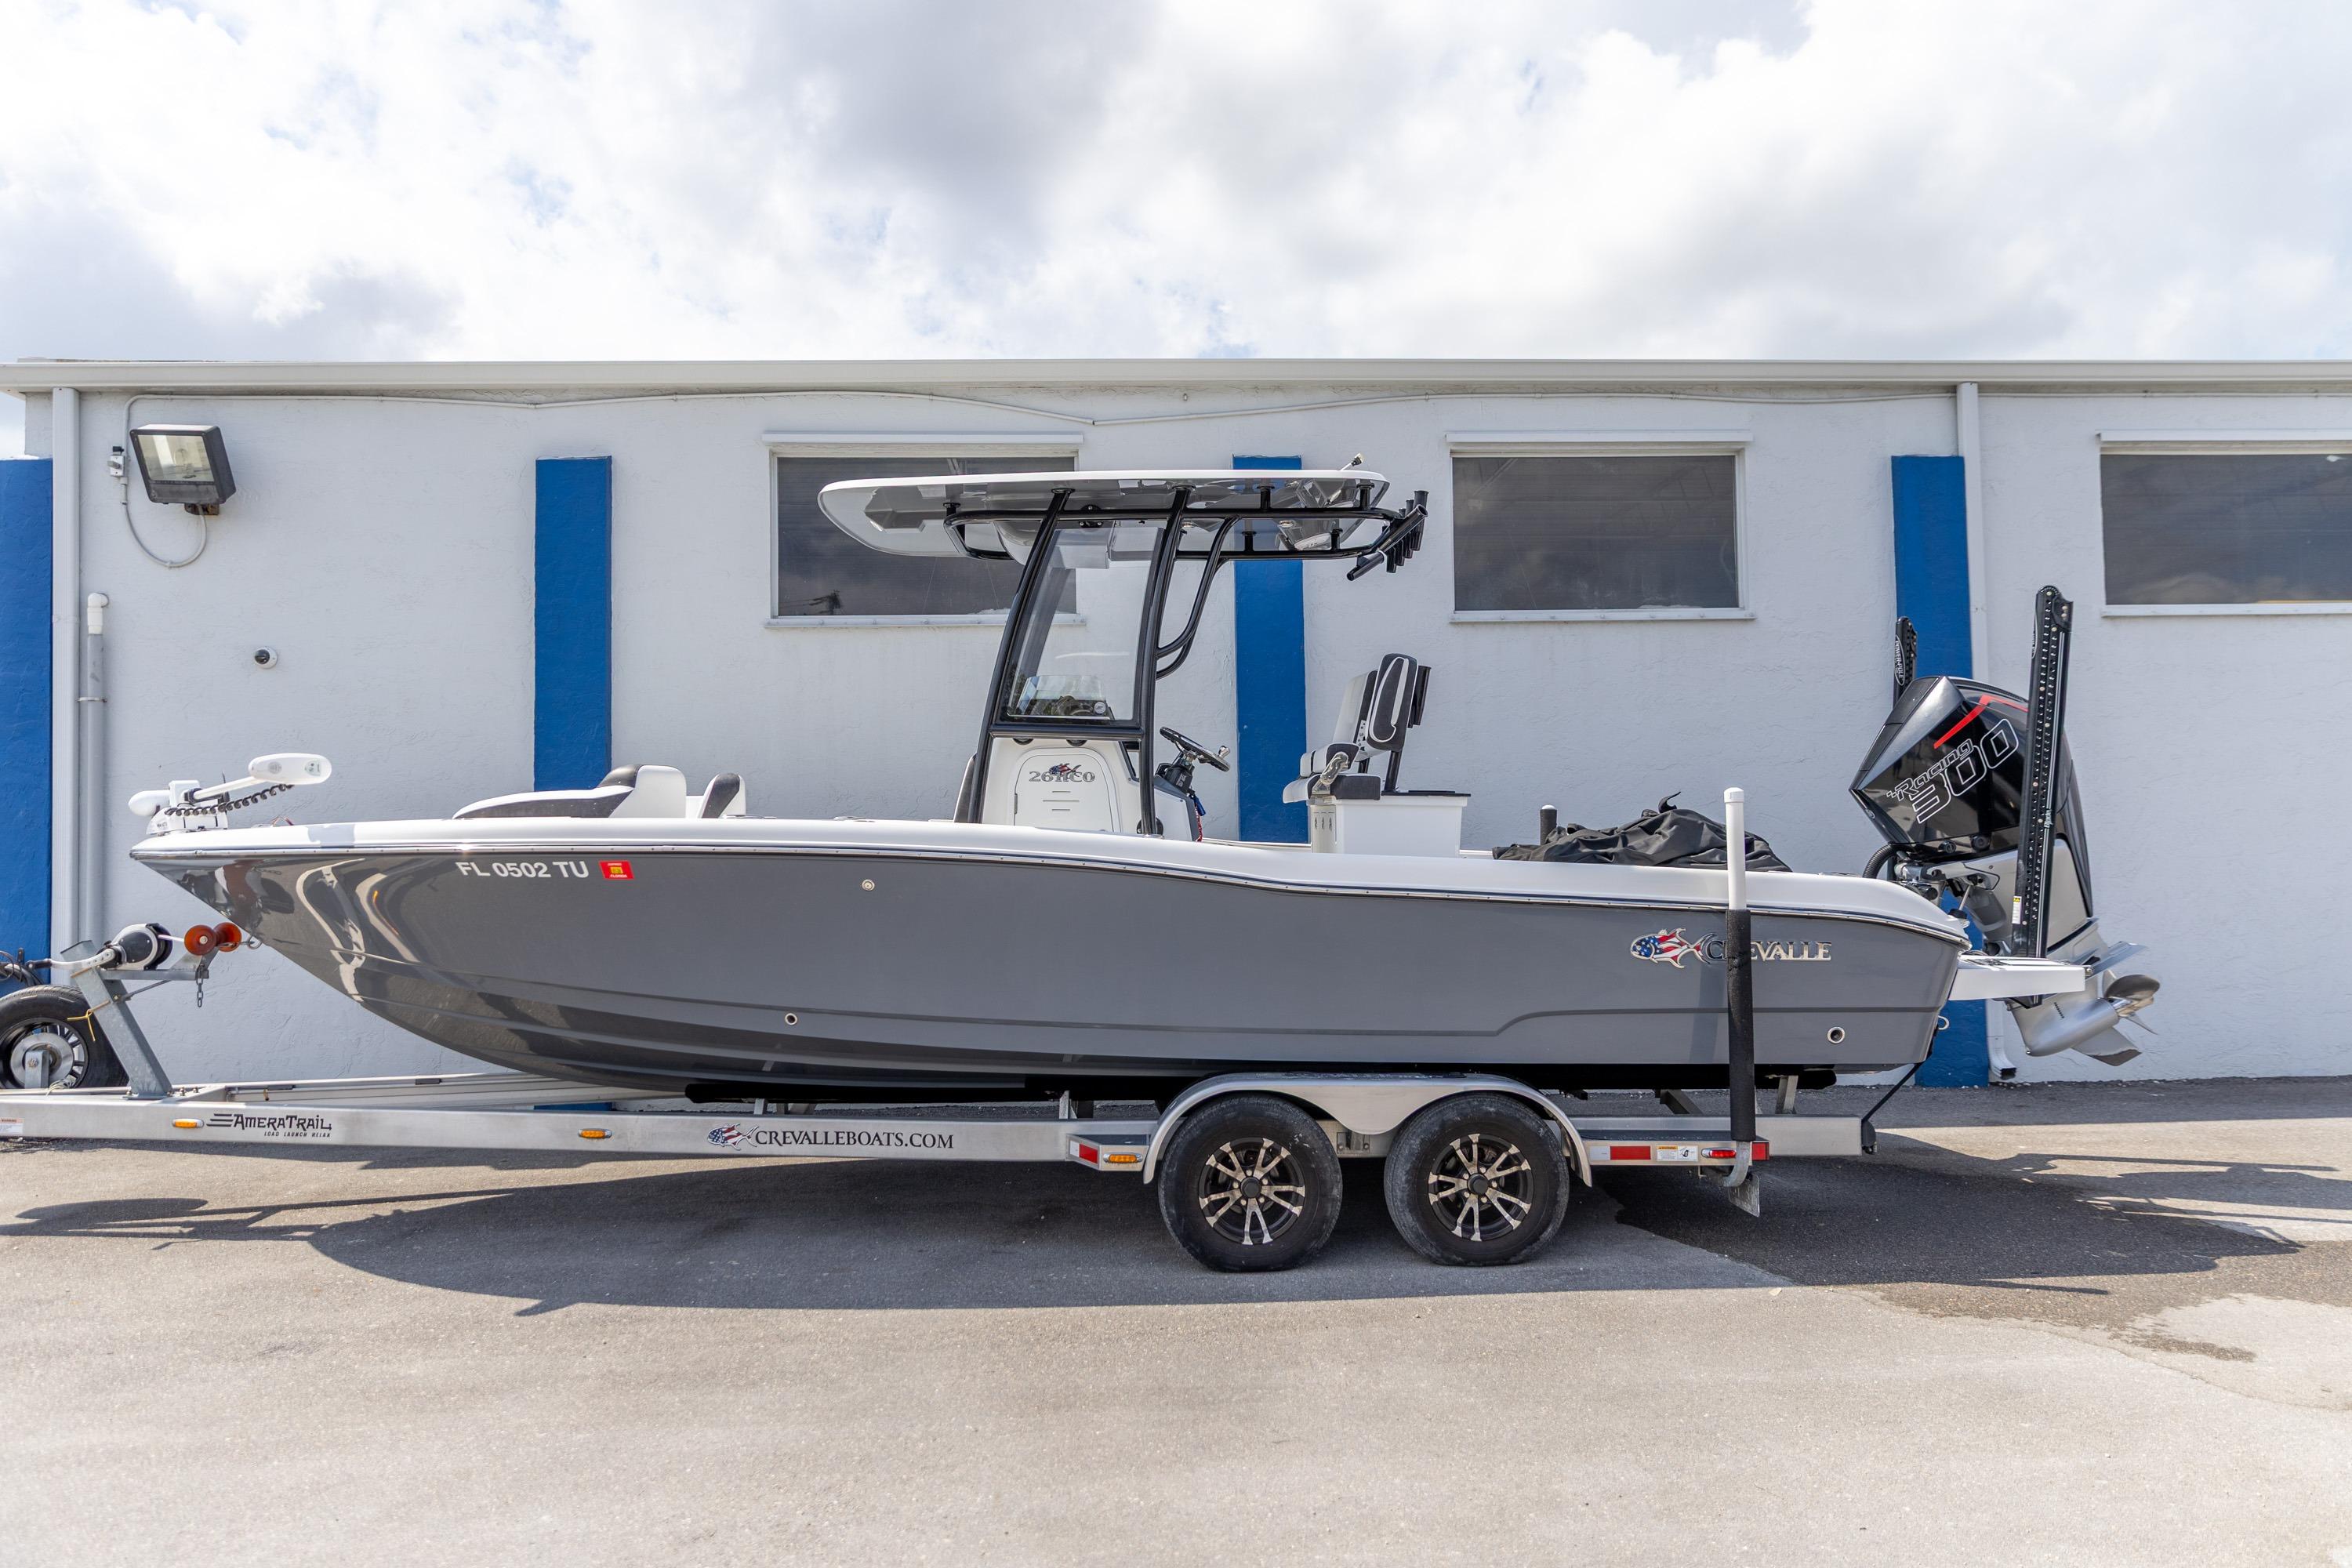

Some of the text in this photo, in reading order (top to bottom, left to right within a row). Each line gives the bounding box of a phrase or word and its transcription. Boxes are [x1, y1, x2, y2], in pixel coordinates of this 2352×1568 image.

[1908, 718, 2019, 824] 300
[456, 861, 589, 878] FL 0502 TU
[1706, 940, 1831, 961] CVALLE
[754, 1130, 954, 1149] CREVALLEBOATS.COM
